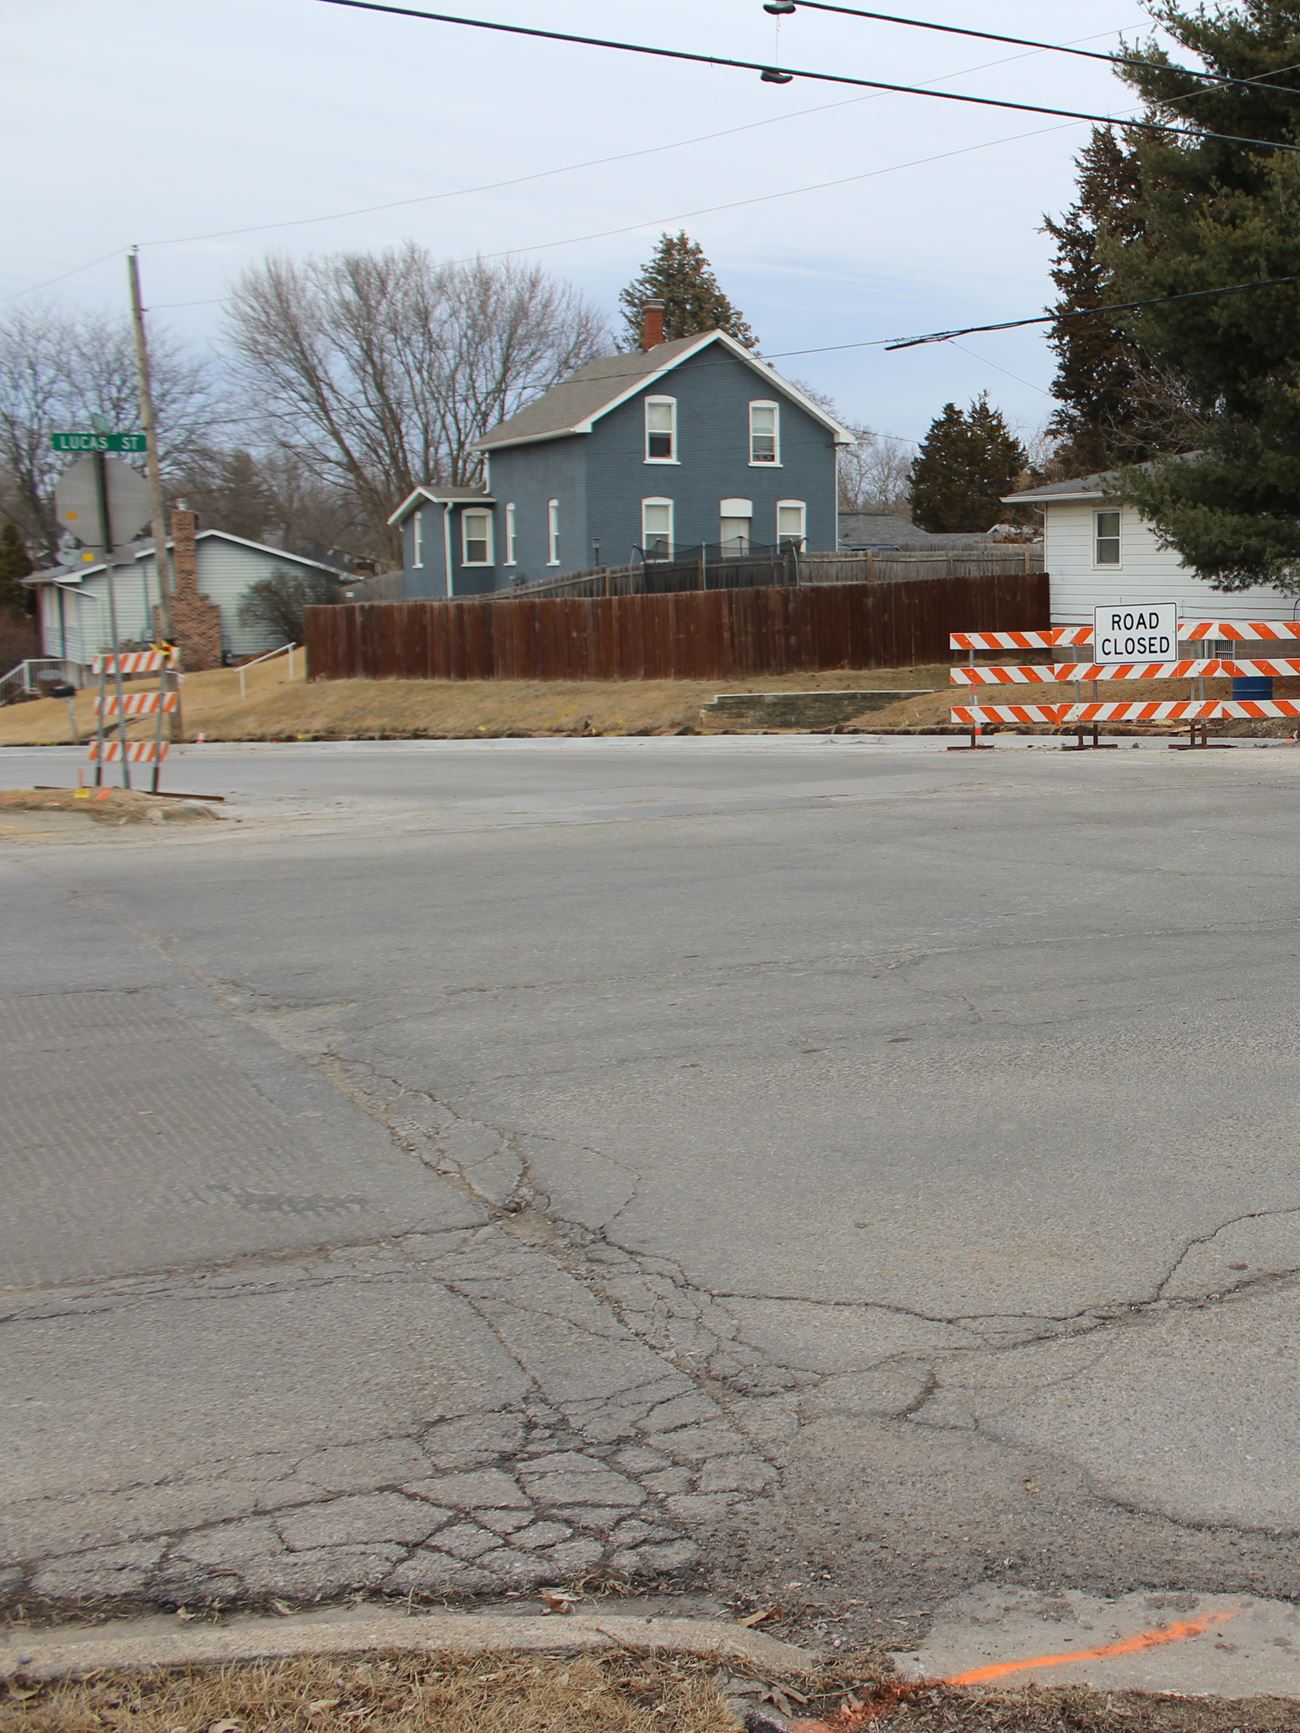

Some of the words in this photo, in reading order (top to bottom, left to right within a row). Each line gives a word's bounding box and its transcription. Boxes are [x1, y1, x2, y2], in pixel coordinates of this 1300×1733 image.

[60, 436, 109, 449] LUCAS
[121, 436, 139, 449] ST
[1111, 612, 1160, 631] ROAD
[1101, 636, 1170, 656] CLOSED
